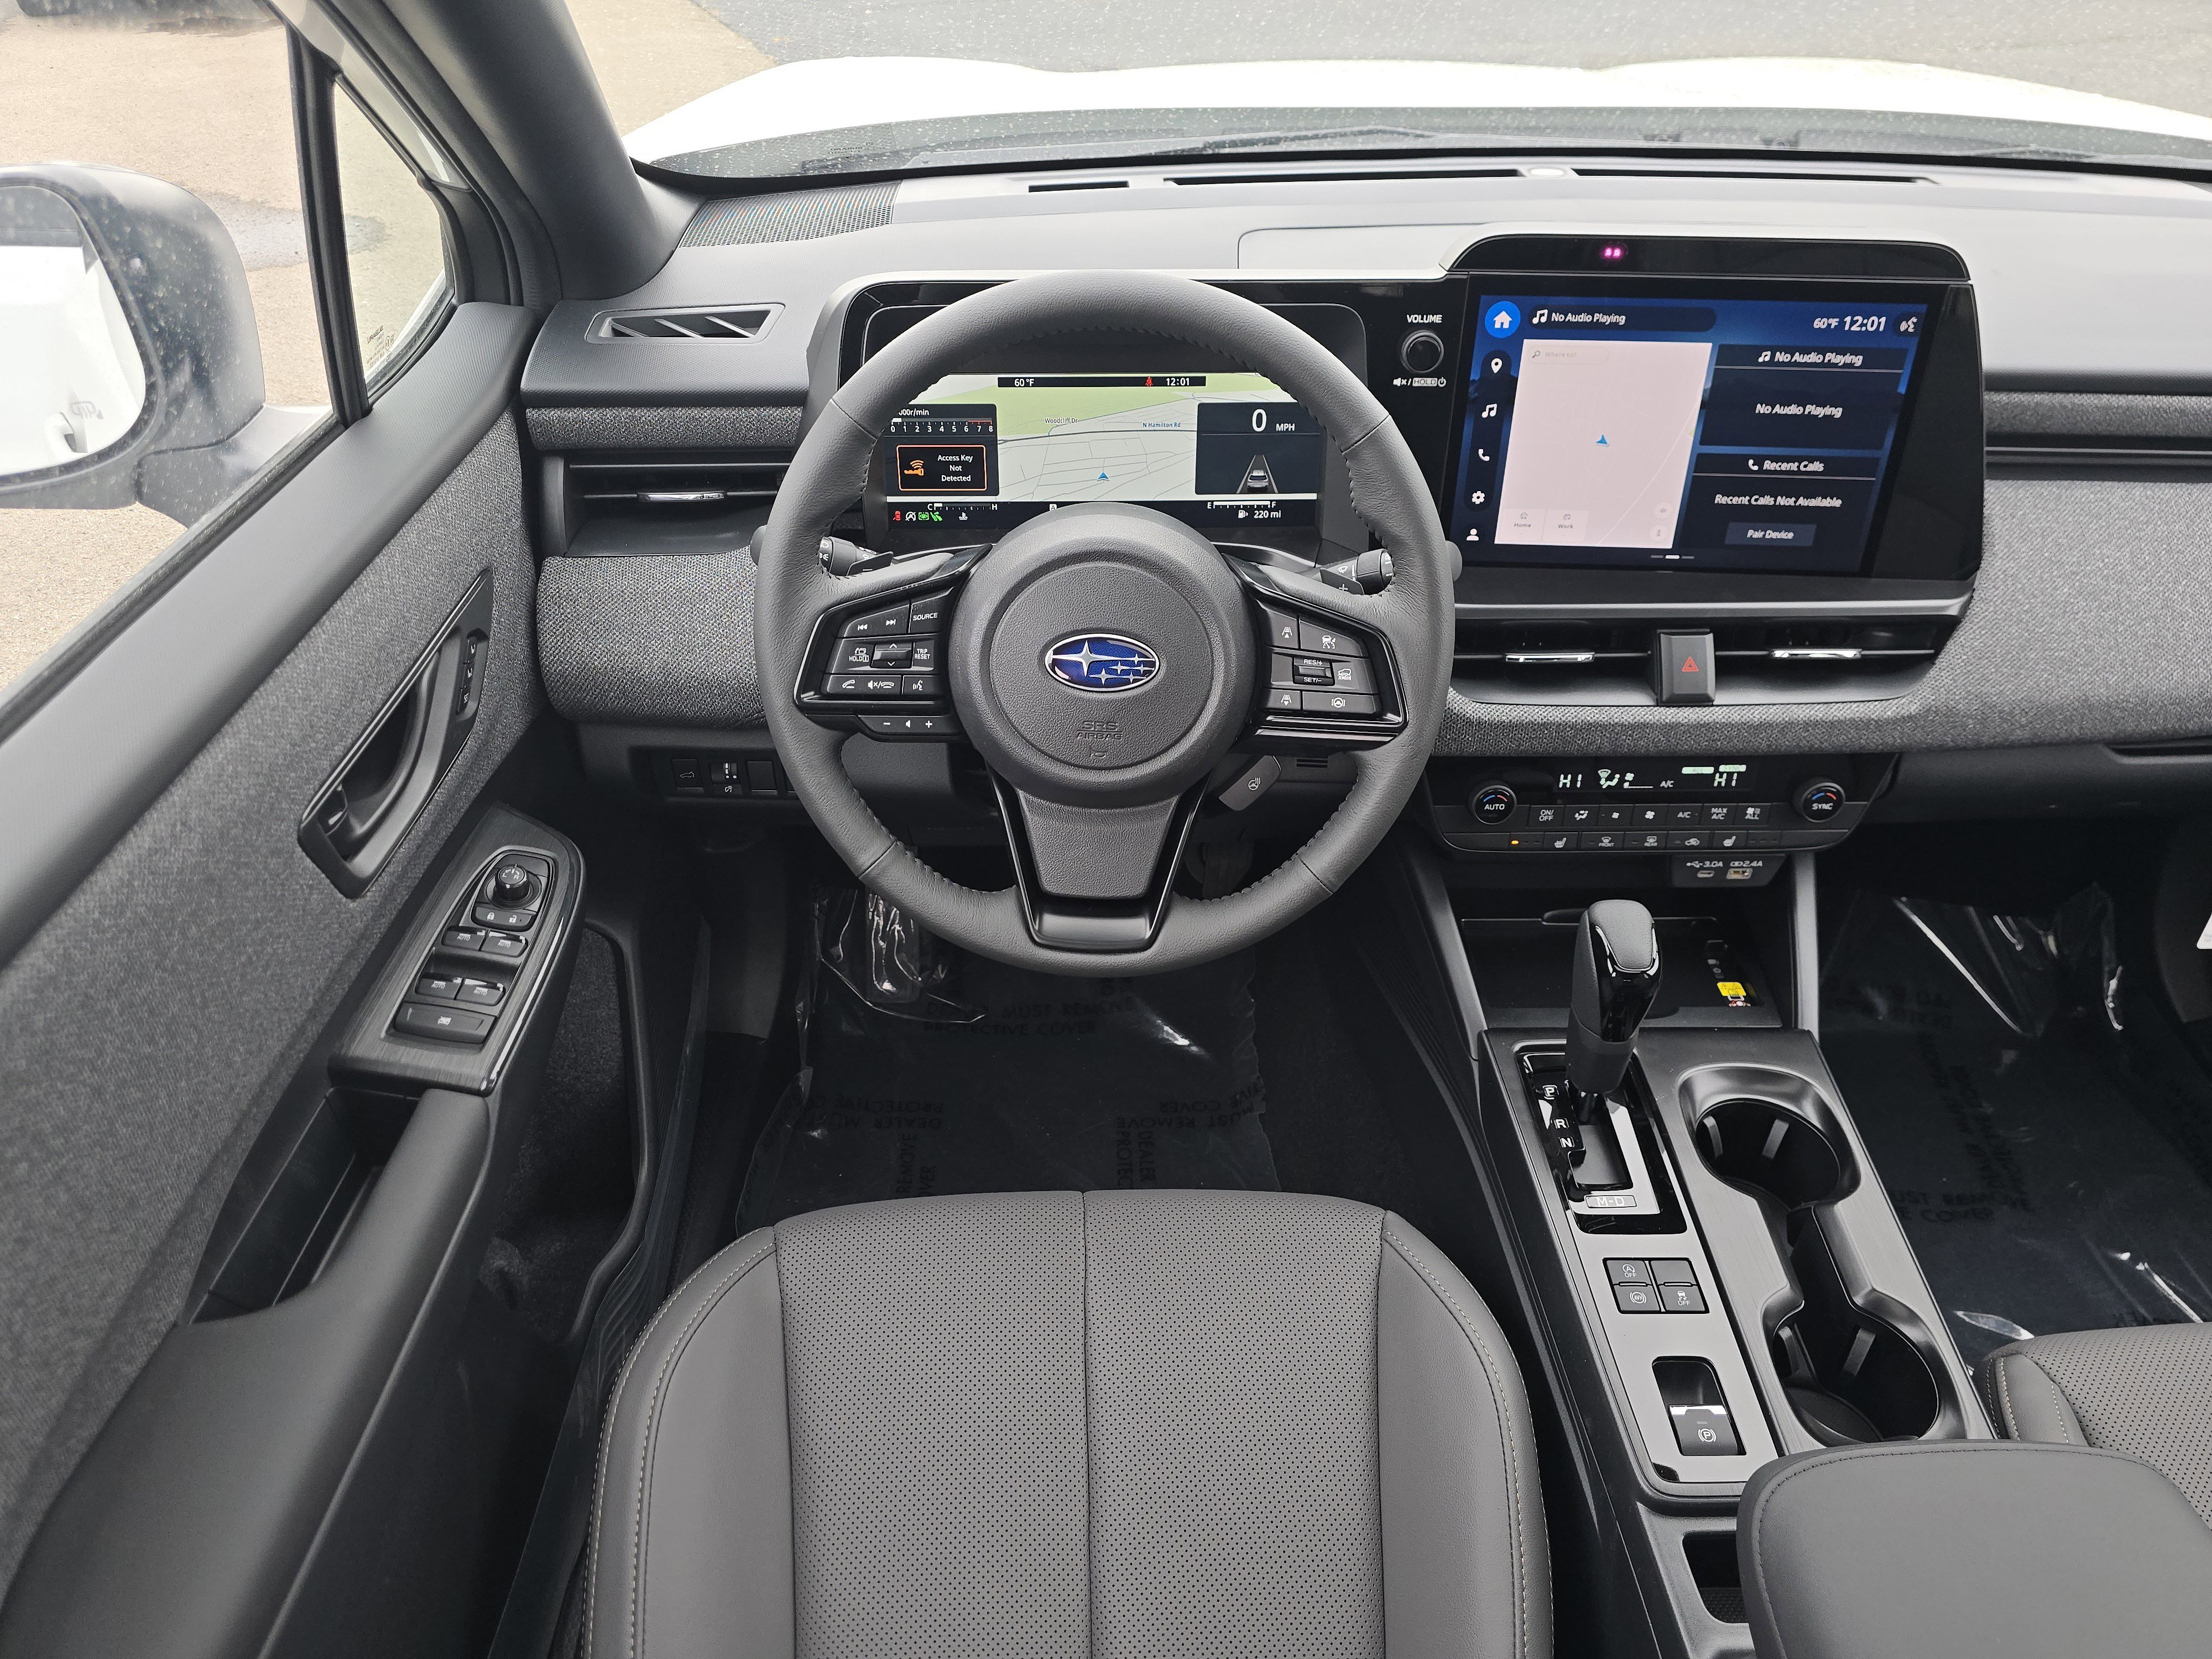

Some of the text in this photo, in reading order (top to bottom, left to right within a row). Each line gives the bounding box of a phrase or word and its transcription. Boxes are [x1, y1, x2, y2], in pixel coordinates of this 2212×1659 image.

[1406, 314, 1443, 324] VOLUME
[1551, 313, 1626, 325] No Audio Playing
[1844, 316, 1886, 332] 12:01
[1774, 351, 1863, 367] No Audio Playing
[1166, 378, 1190, 386] 12:01
[1755, 403, 1843, 419] No Audio Playing
[1252, 409, 1295, 432] 0 MPH
[1763, 460, 1824, 472] Recent Calls
[1715, 494, 1842, 507] Recent Calls Not Available
[1270, 510, 1281, 518] mi
[1747, 529, 1794, 539] Pair Device
[912, 612, 938, 621] SOURCE
[1082, 721, 1119, 731] SRS
[1002, 1003, 1051, 1019] MUST
[924, 1020, 1098, 1036] PROTECTIVE COVER
[1546, 1087, 1555, 1097] P
[1159, 1099, 1222, 1114] COVER
[873, 1116, 941, 1130] DEALER
[1115, 1116, 1196, 1129] REMOVE
[1556, 1119, 1567, 1129] R
[1561, 1138, 1573, 1147] N
[1116, 1130, 1134, 1188] PROTEC
[1138, 1130, 1156, 1182] DEALER
[895, 1133, 917, 1194] REMOVE
[917, 1165, 937, 1196] VER
[1891, 1190, 1929, 1206] UST
